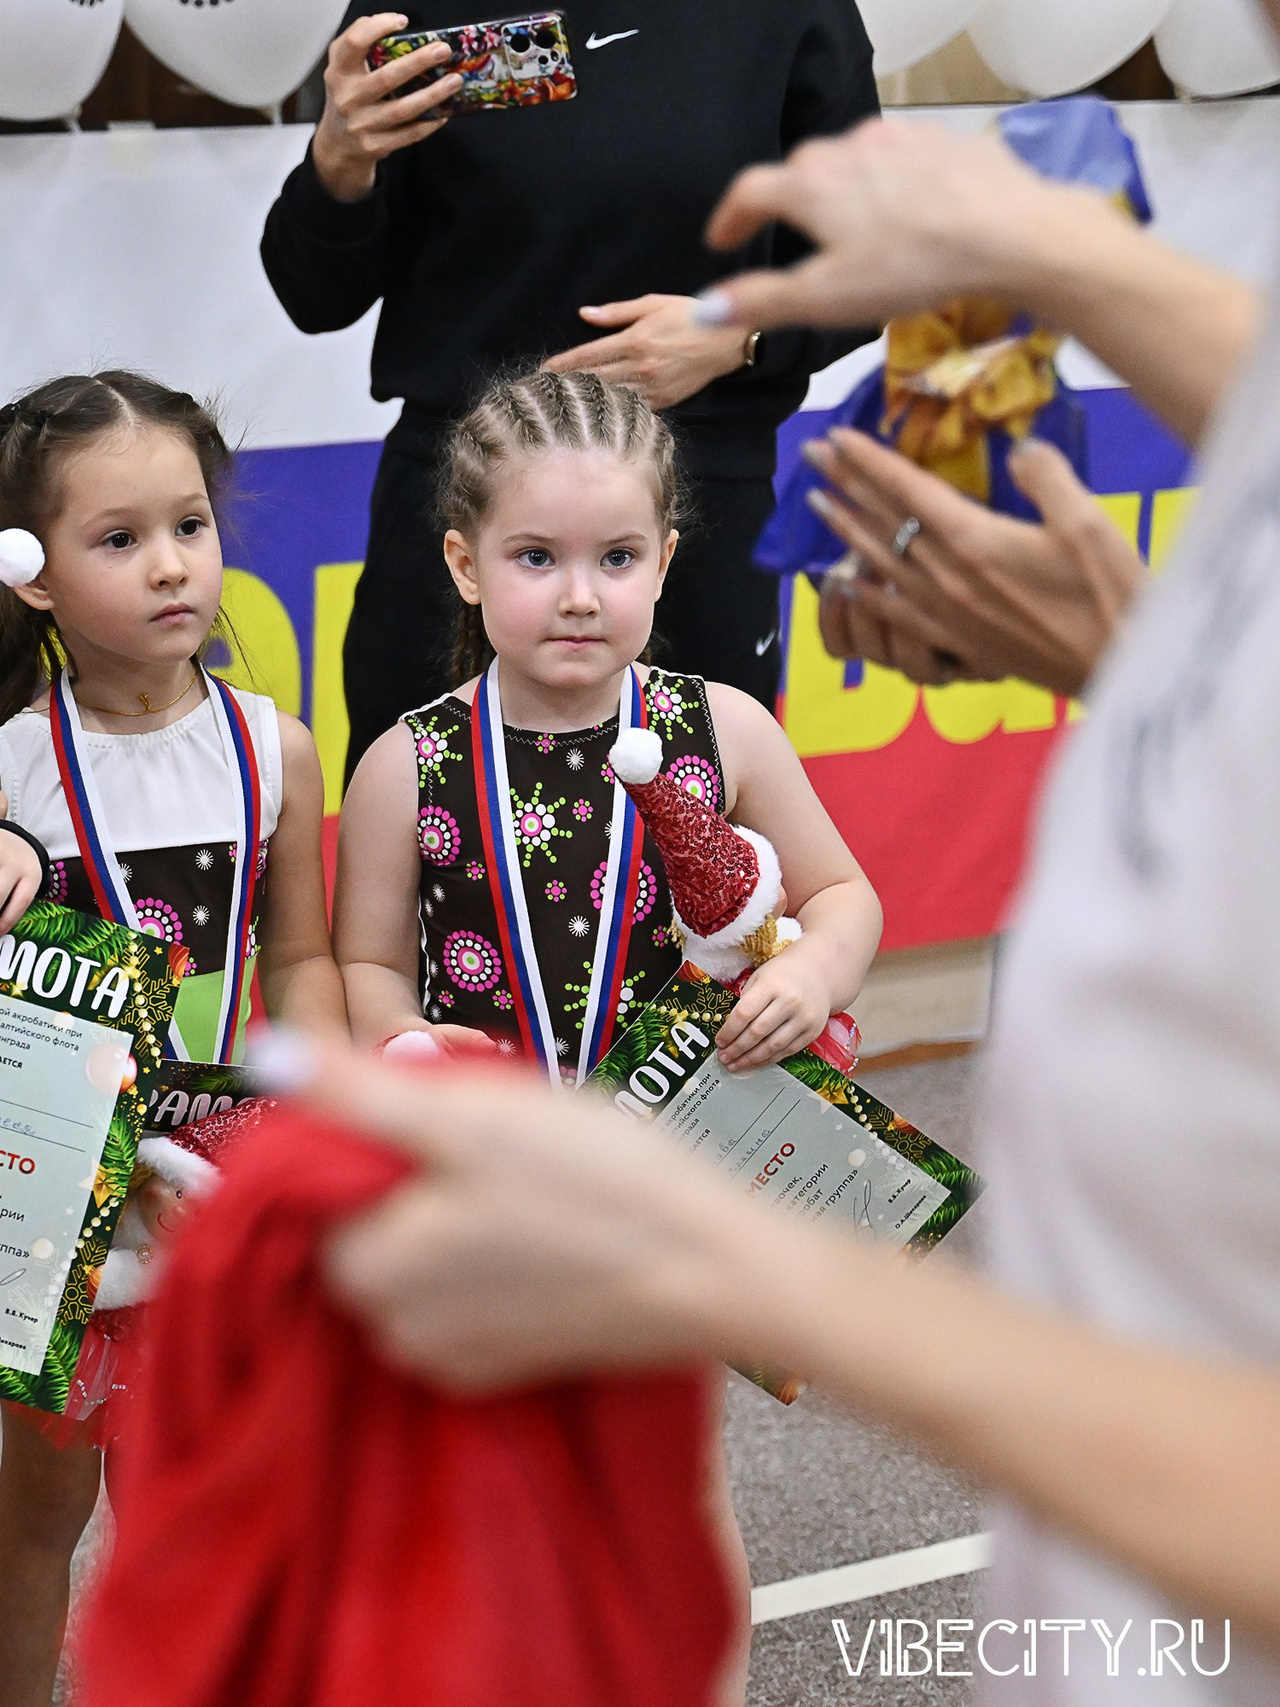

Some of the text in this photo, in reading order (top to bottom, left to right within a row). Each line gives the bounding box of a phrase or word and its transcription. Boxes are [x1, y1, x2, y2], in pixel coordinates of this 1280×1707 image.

[12, 1012, 64, 1034] акробатики
[65, 1027, 83, 1039] при
[52, 1036, 80, 1052] флота
[699, 1073, 712, 1089] при
[700, 1078, 721, 1102] флота
[744, 1141, 796, 1199] МЕСТО
[825, 1169, 859, 1208] группа»
